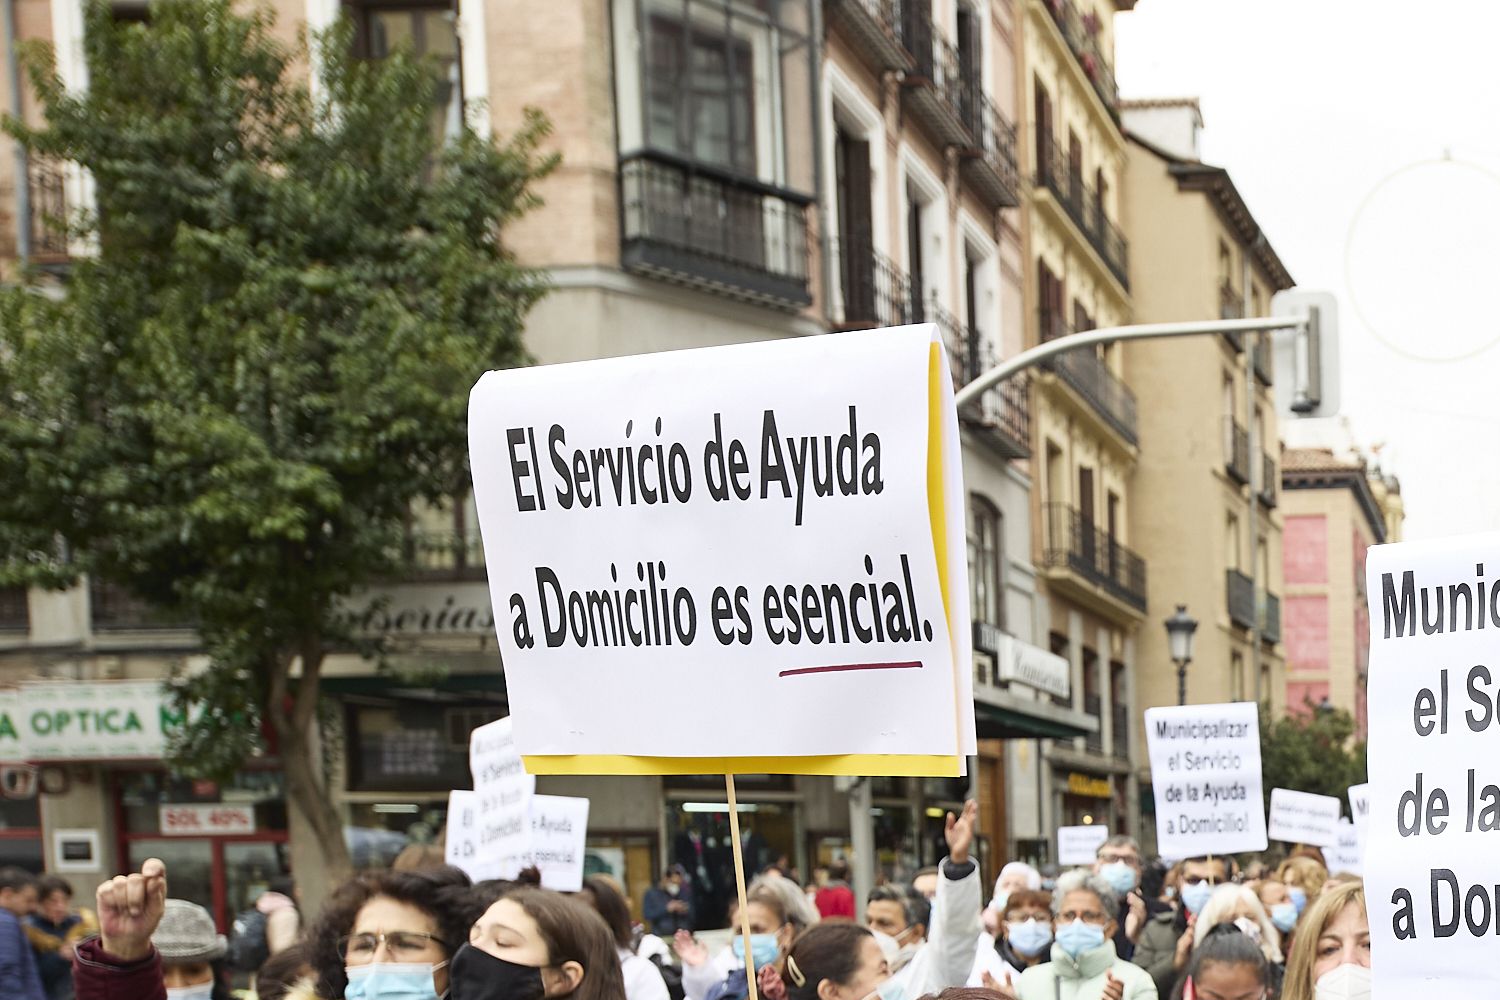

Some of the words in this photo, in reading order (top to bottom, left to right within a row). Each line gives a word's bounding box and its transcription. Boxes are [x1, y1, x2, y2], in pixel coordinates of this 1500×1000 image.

[507, 427, 546, 511] El
[703, 412, 752, 502] de
[759, 405, 884, 527] Ayuda
[509, 592, 535, 649] a
[535, 561, 697, 648] Domicilio
[711, 585, 753, 646] es
[763, 554, 933, 645] esencial.
[1156, 721, 1248, 742] Municipalizar
[1413, 668, 1449, 737] el
[1168, 752, 1180, 771] el
[1184, 751, 1241, 771] Servicio
[1165, 783, 1182, 802] de
[1187, 783, 1198, 801] la
[1203, 782, 1247, 807] Ayuda
[1398, 773, 1450, 837] de
[1390, 887, 1417, 941] a
